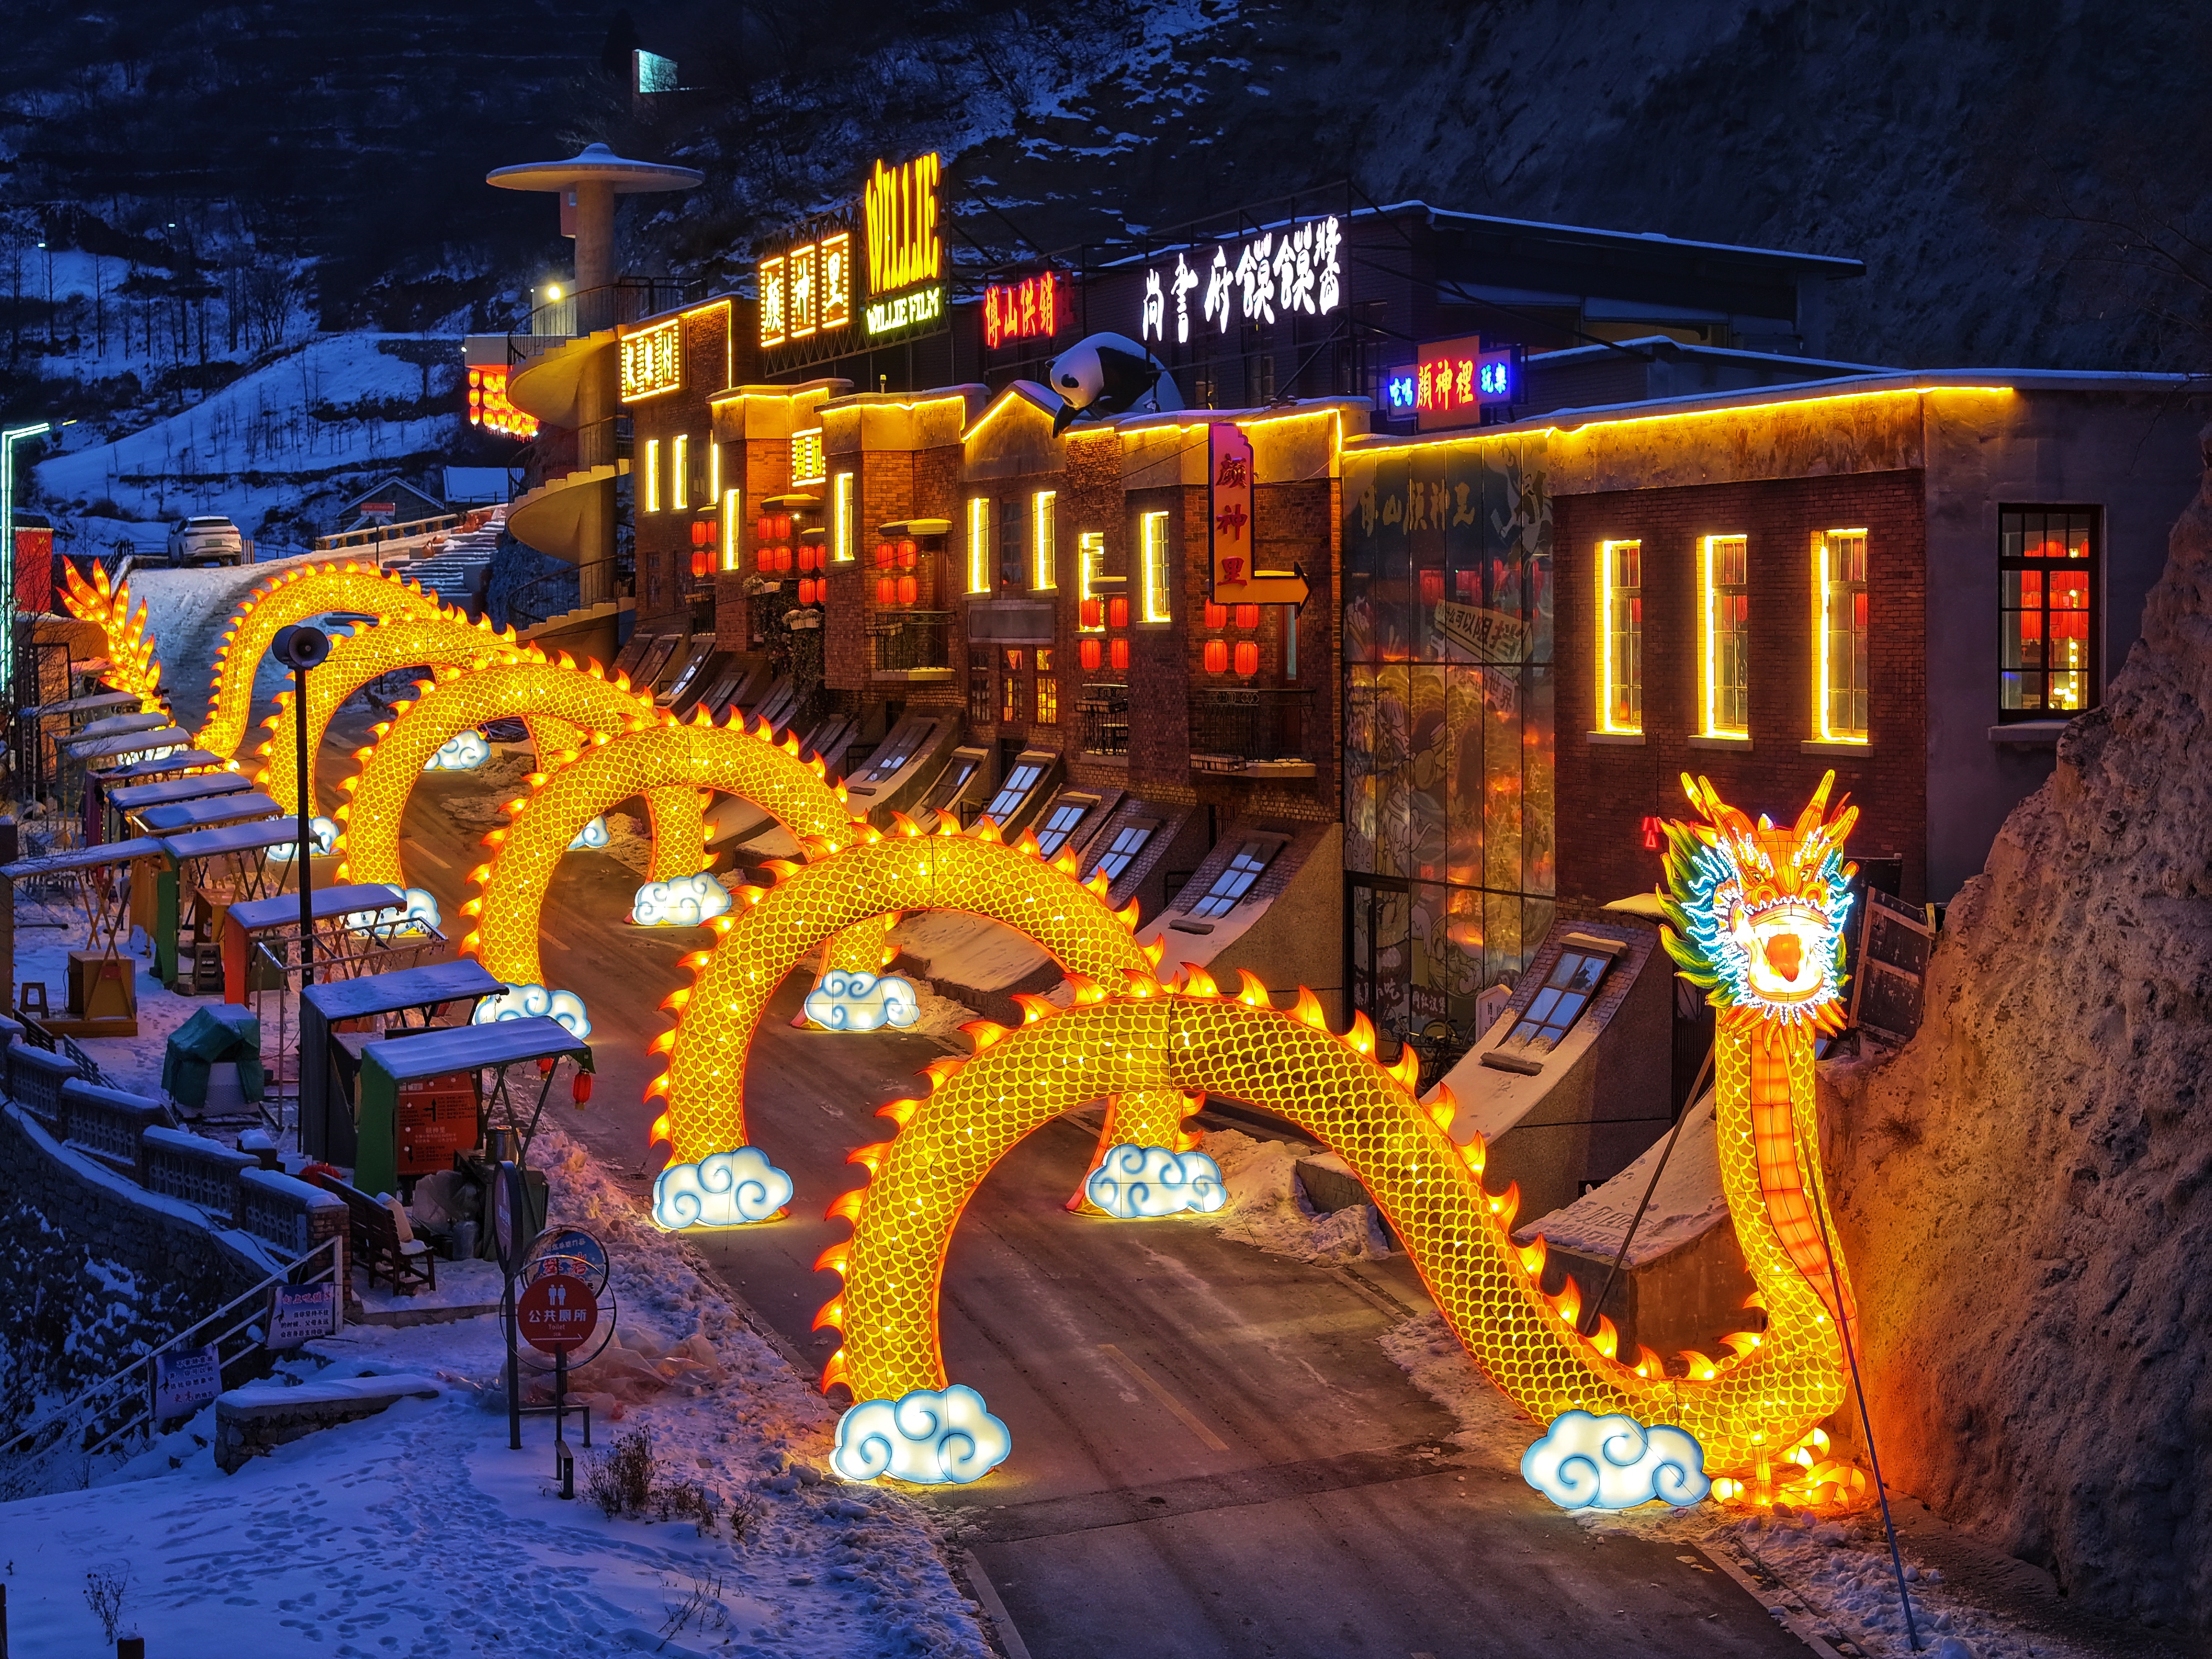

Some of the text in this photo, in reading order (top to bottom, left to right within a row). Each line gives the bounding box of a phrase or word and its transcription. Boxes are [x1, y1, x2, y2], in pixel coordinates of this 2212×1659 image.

[866, 287, 940, 335] WILLIE FILM
[529, 1309, 587, 1323] 公共厕所
